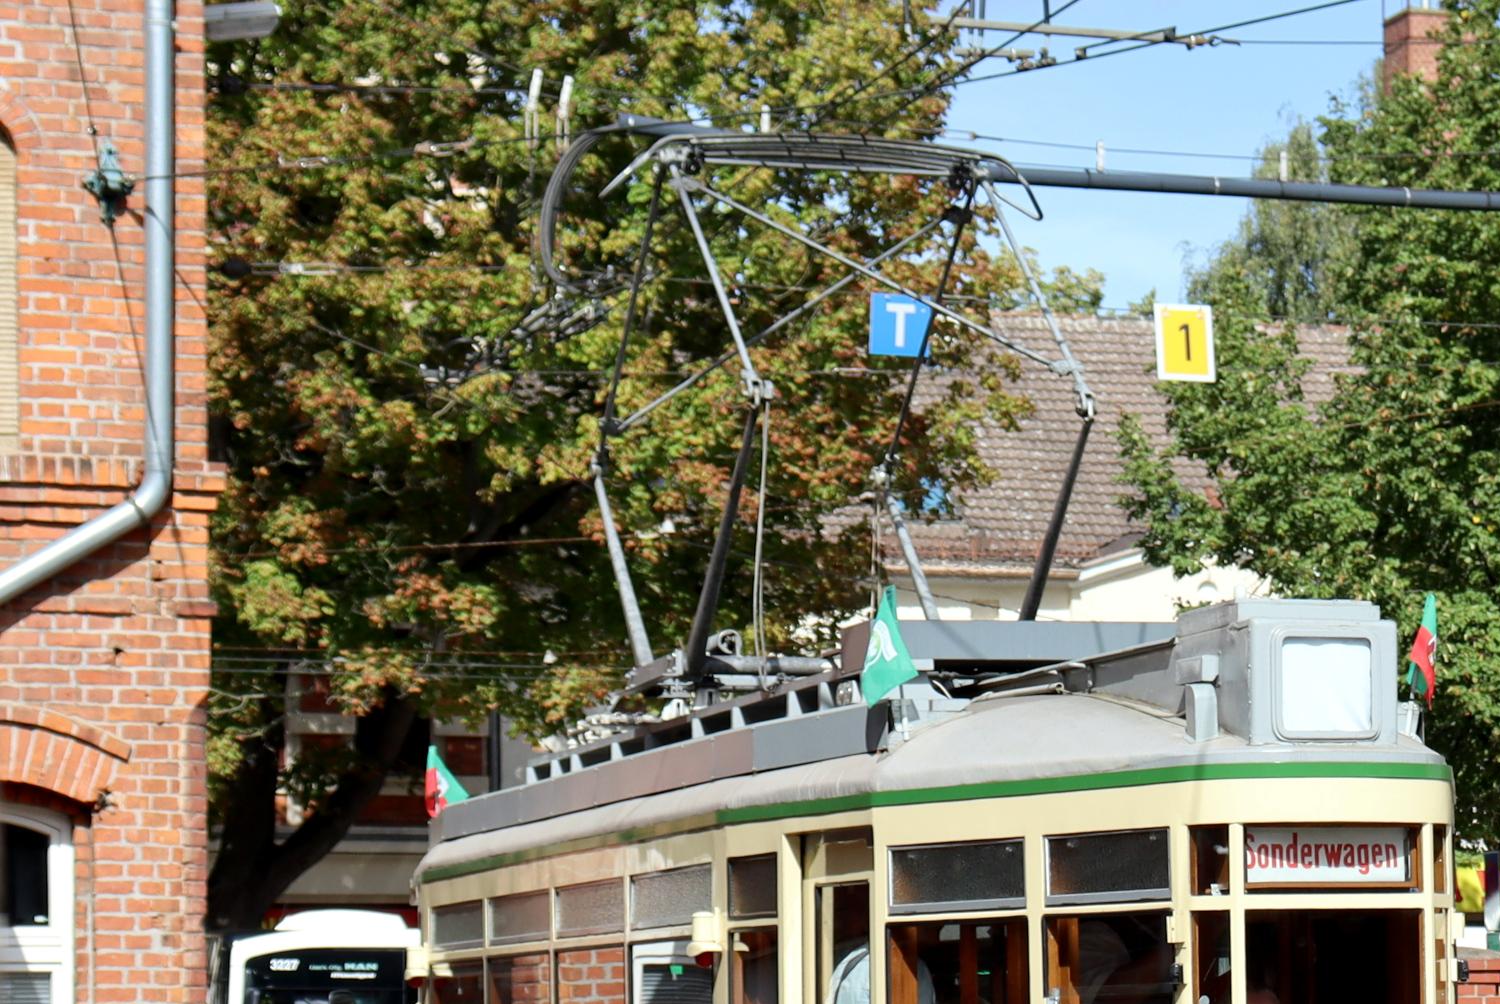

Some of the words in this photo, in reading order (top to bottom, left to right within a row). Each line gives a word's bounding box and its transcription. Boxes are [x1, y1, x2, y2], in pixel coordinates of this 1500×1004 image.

[886, 302, 916, 348] T
[1178, 323, 1192, 362] 1
[1246, 831, 1398, 875] Sonderwagen
[269, 958, 300, 971] 3227
